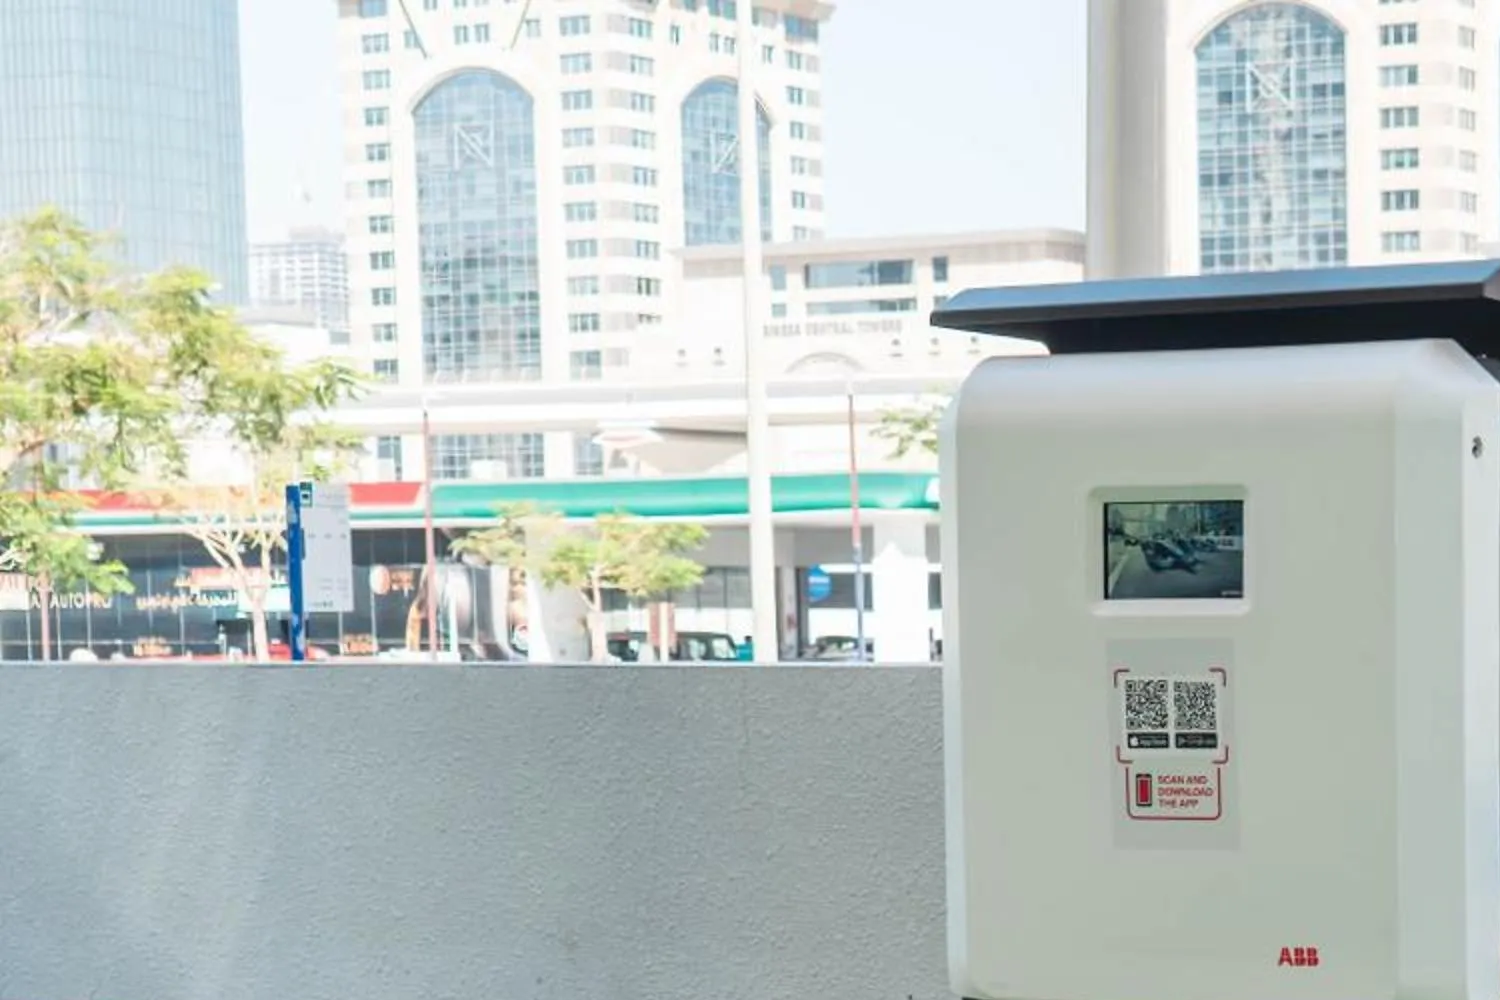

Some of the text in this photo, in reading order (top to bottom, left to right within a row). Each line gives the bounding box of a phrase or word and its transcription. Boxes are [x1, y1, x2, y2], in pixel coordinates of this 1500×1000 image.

[1157, 775, 1208, 785] SCAN AND
[1157, 787, 1214, 797] DOWNLOAD
[1158, 799, 1199, 808] THE APP
[1277, 946, 1319, 967] ABB
